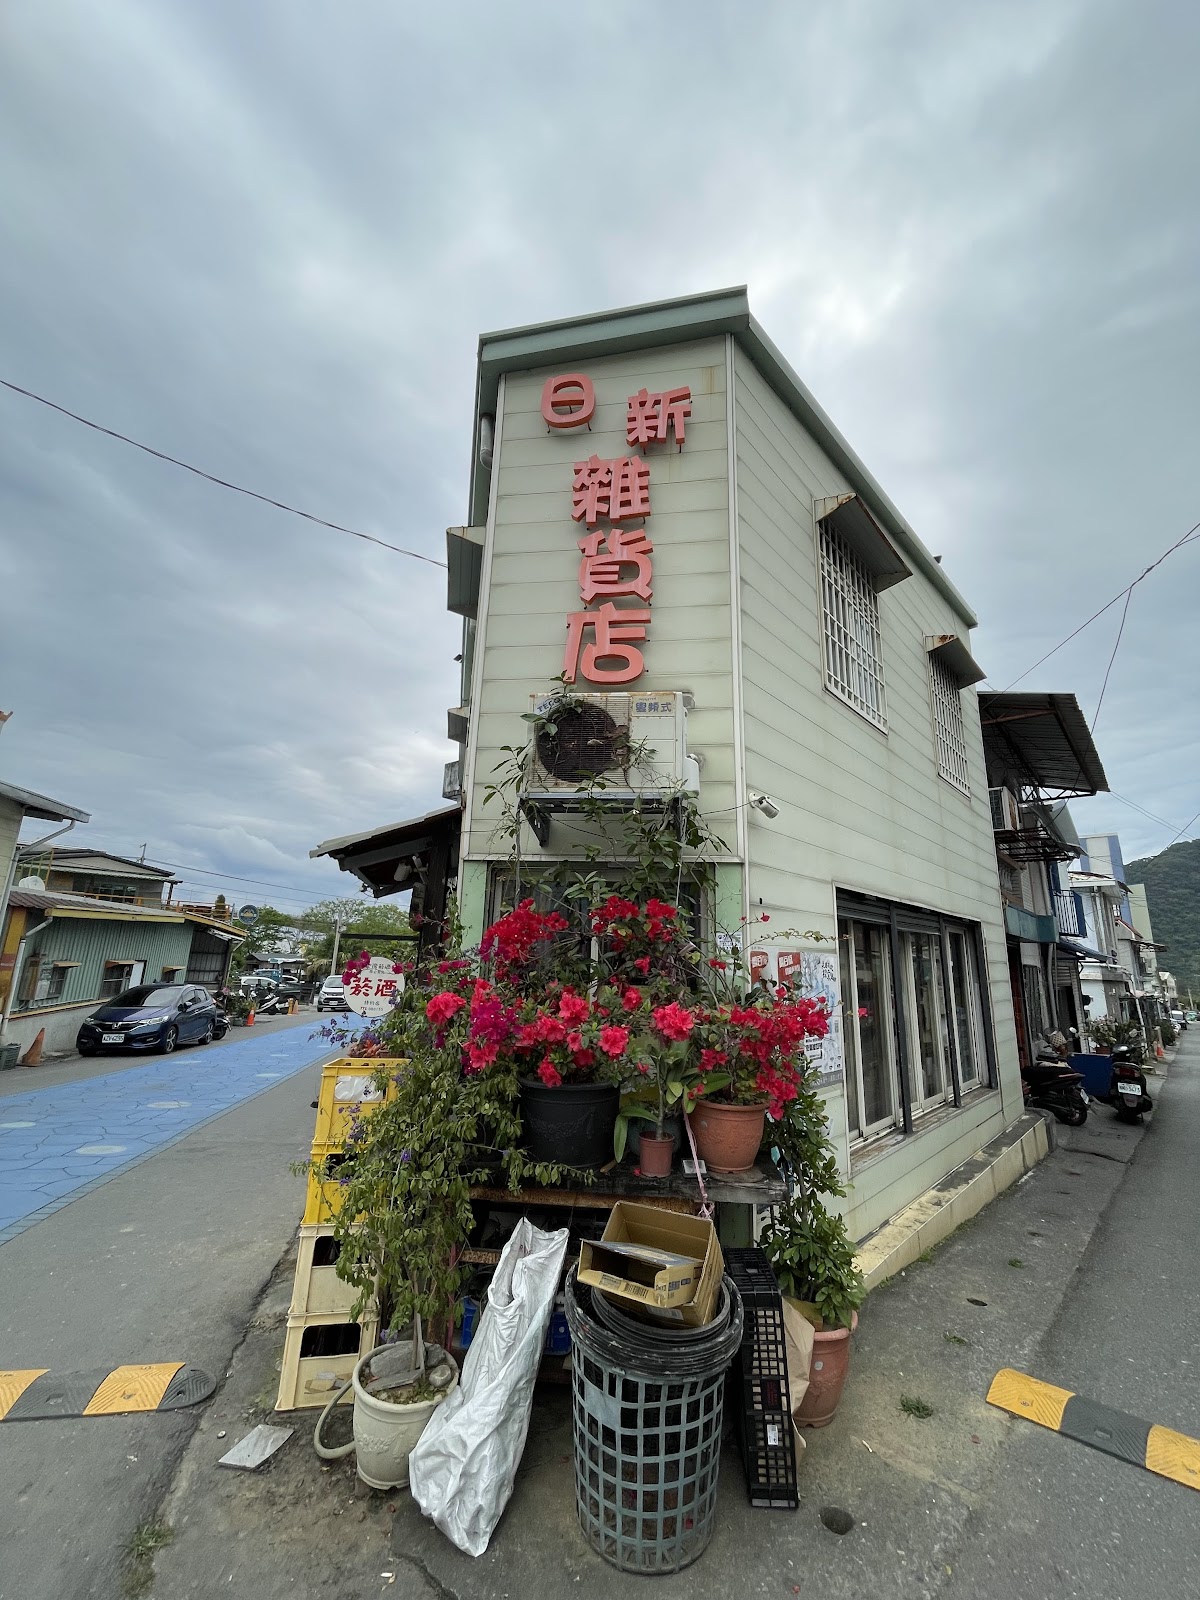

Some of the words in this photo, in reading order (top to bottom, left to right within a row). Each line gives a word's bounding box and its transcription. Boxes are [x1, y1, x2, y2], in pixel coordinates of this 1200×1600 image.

[563, 454, 653, 685] 雜貨店
[537, 696, 562, 712] TECO
[350, 977, 397, 996] 菸酒
